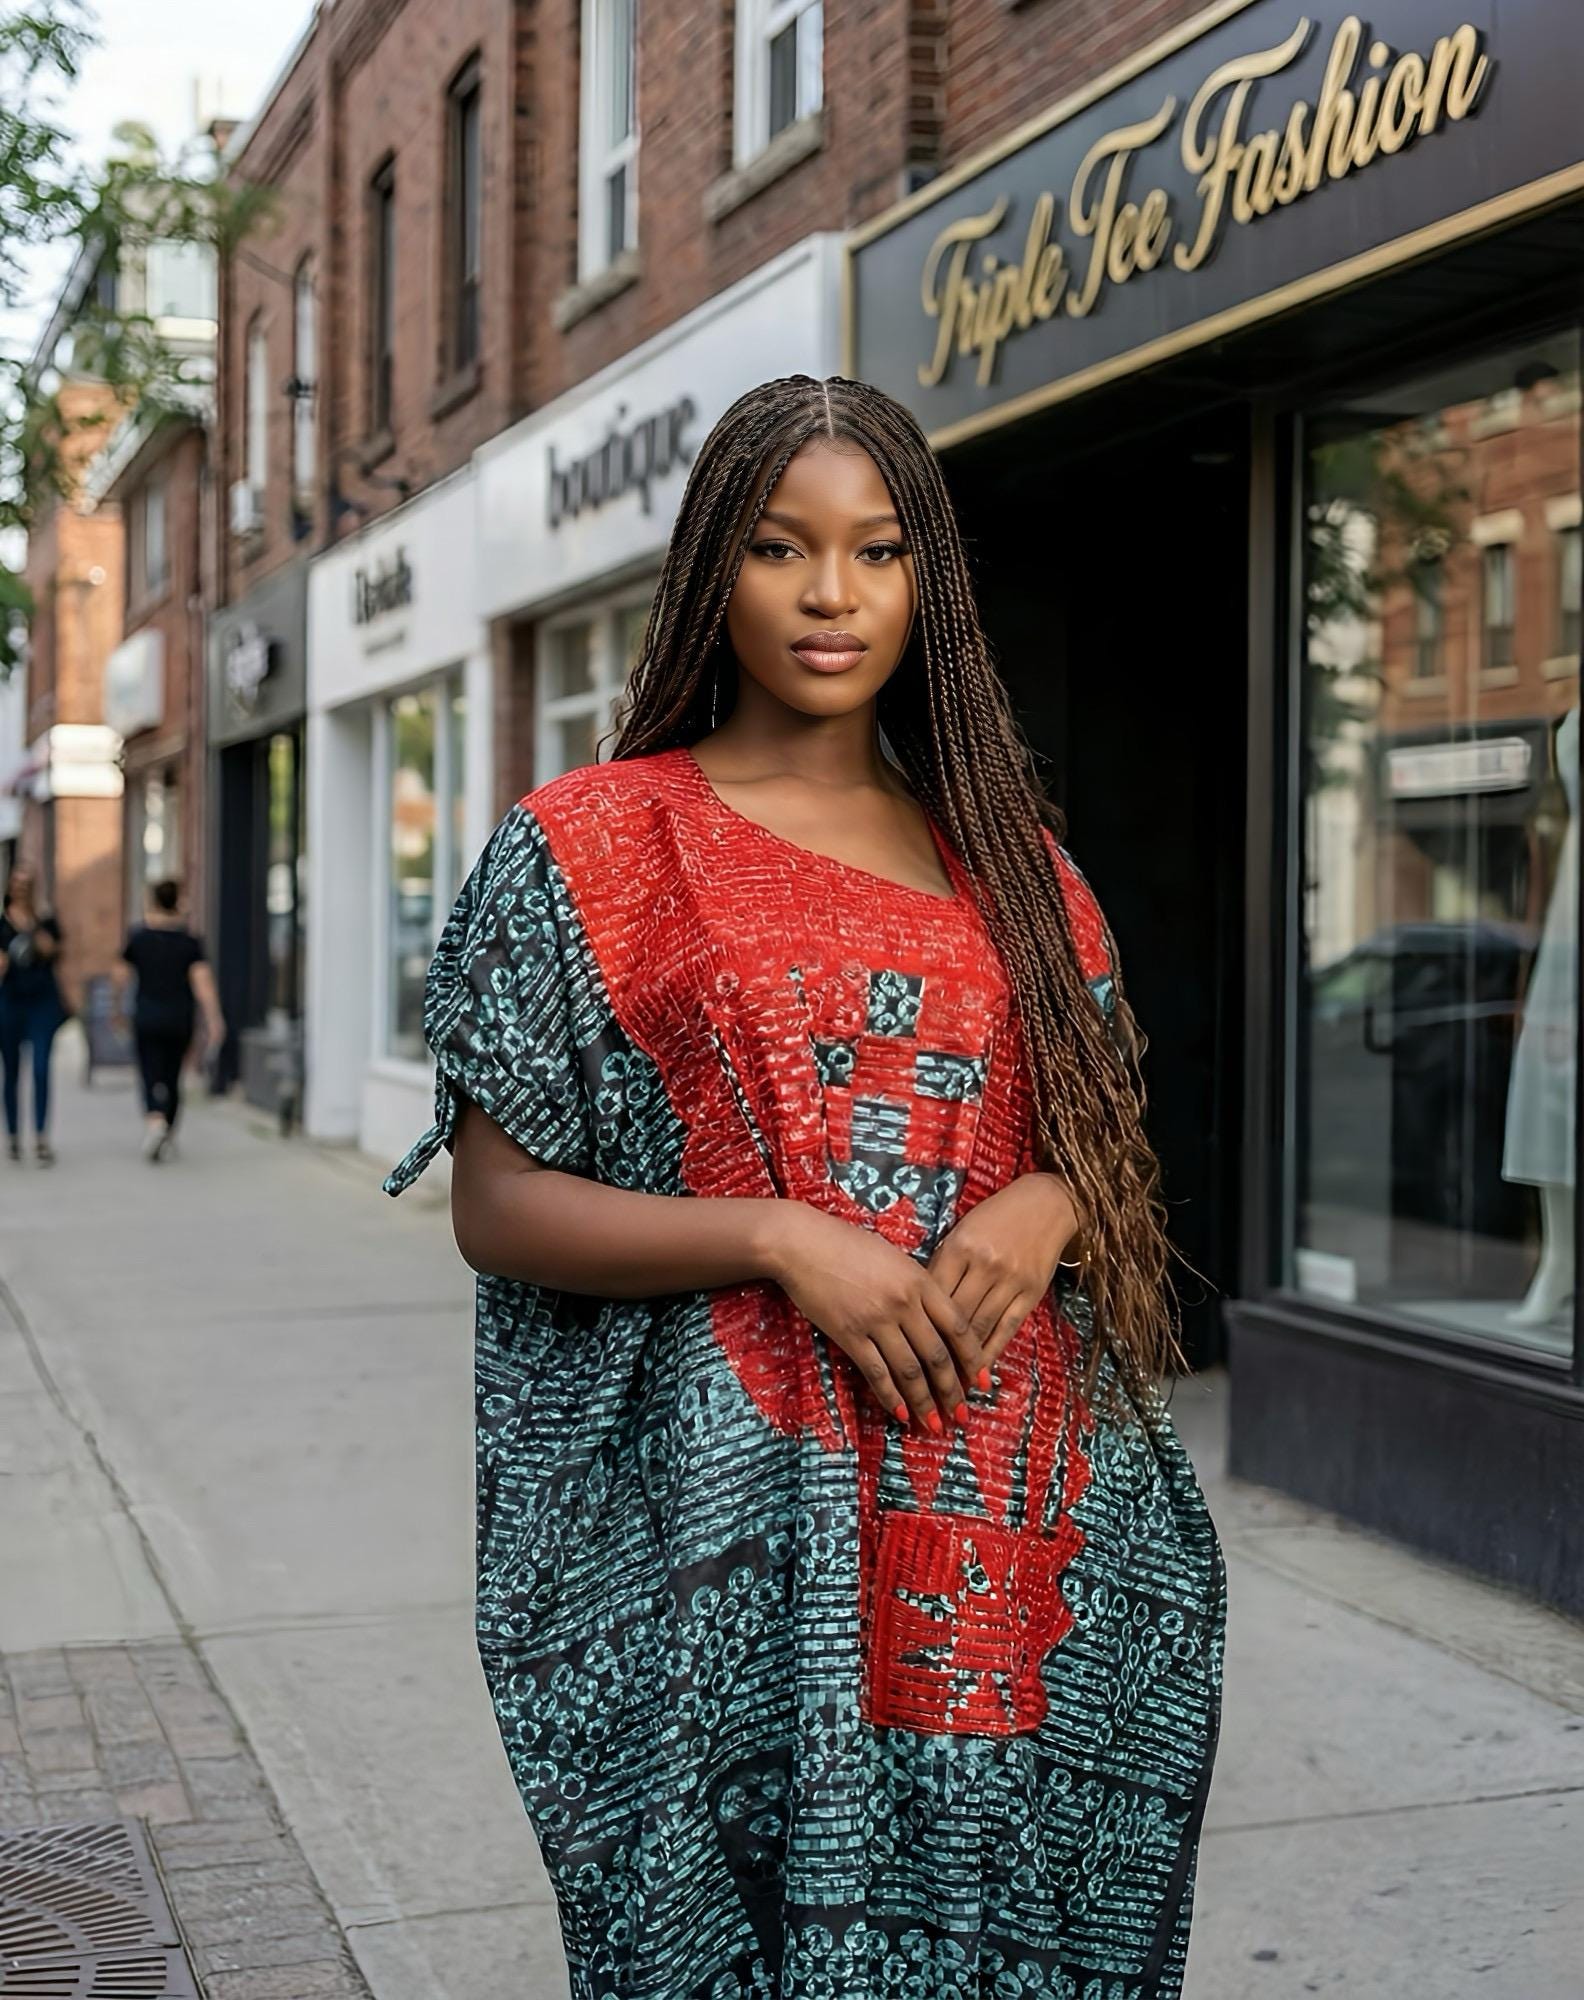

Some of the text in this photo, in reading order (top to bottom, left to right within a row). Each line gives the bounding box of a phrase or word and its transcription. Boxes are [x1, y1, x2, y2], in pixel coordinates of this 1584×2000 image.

[918, 14, 1490, 387] Triple Tee Fashion
